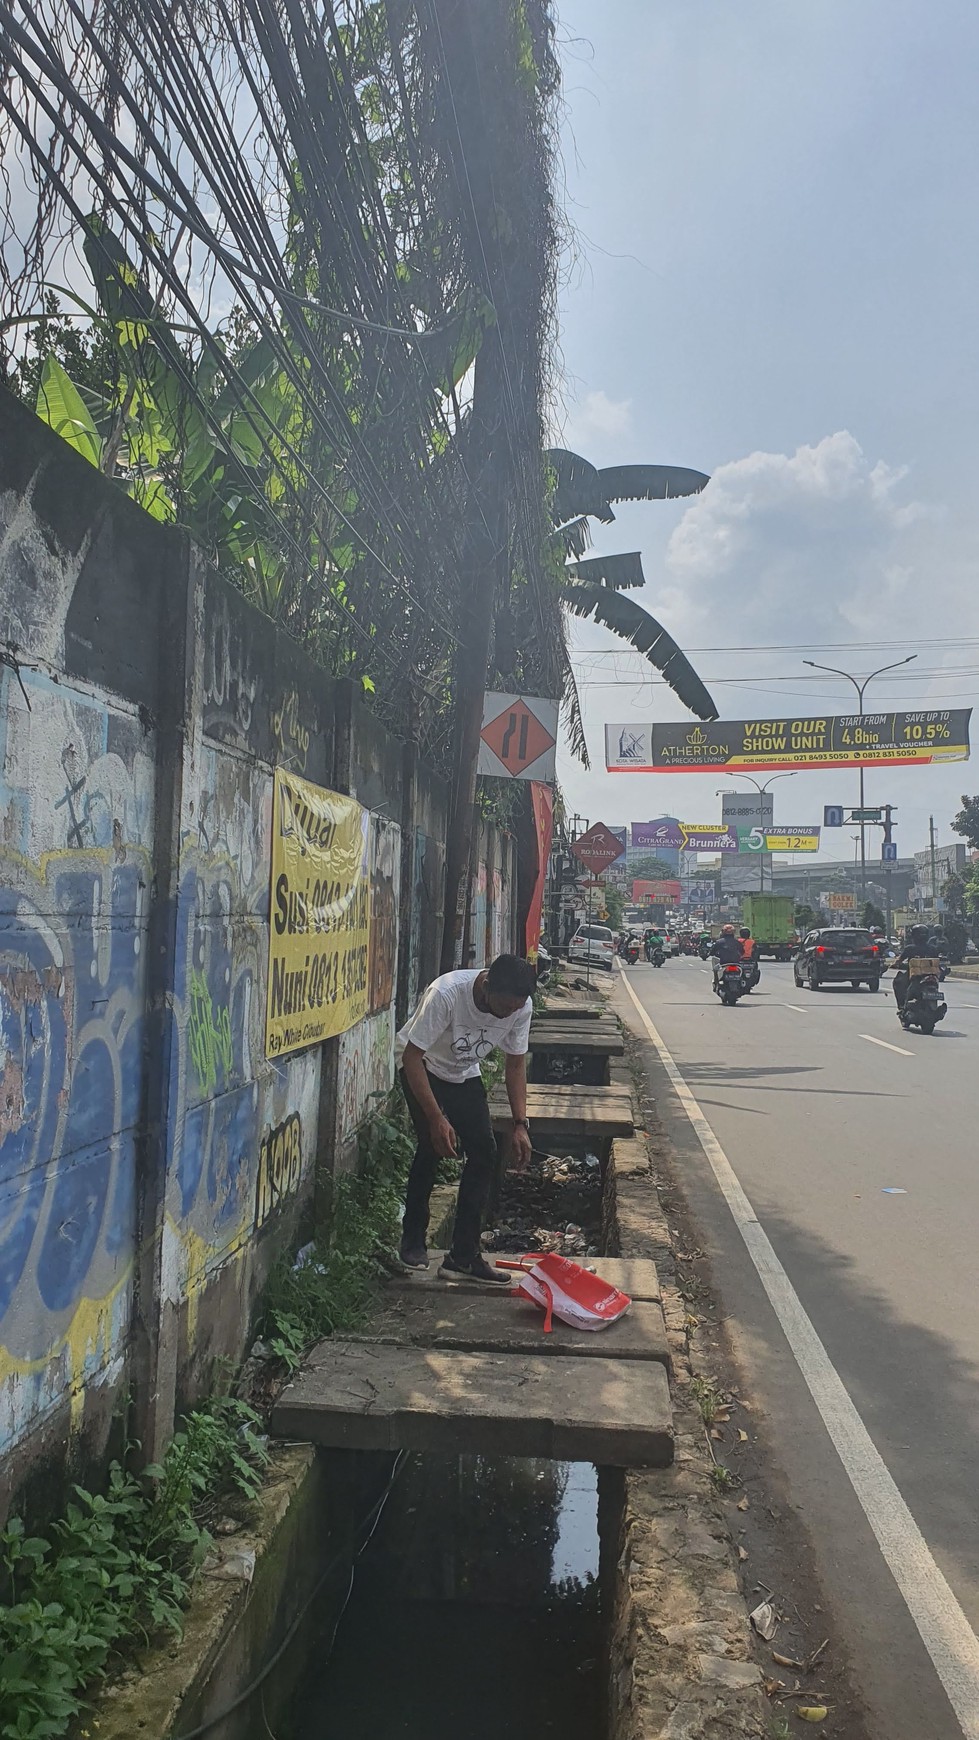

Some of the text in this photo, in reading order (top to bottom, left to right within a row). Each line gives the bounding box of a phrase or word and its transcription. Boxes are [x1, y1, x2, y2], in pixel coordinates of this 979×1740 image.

[840, 715, 887, 726] START FROM
[905, 712, 950, 722] SAVE UP TO
[744, 720, 826, 736] VISIT OUR
[903, 723, 950, 740] 10,5%
[661, 745, 728, 756] ATHERTON
[743, 736, 826, 750] SHOW UNIT
[274, 874, 310, 935] Susi
[270, 956, 310, 1019] Nuni
[269, 1034, 283, 1053] Ray
